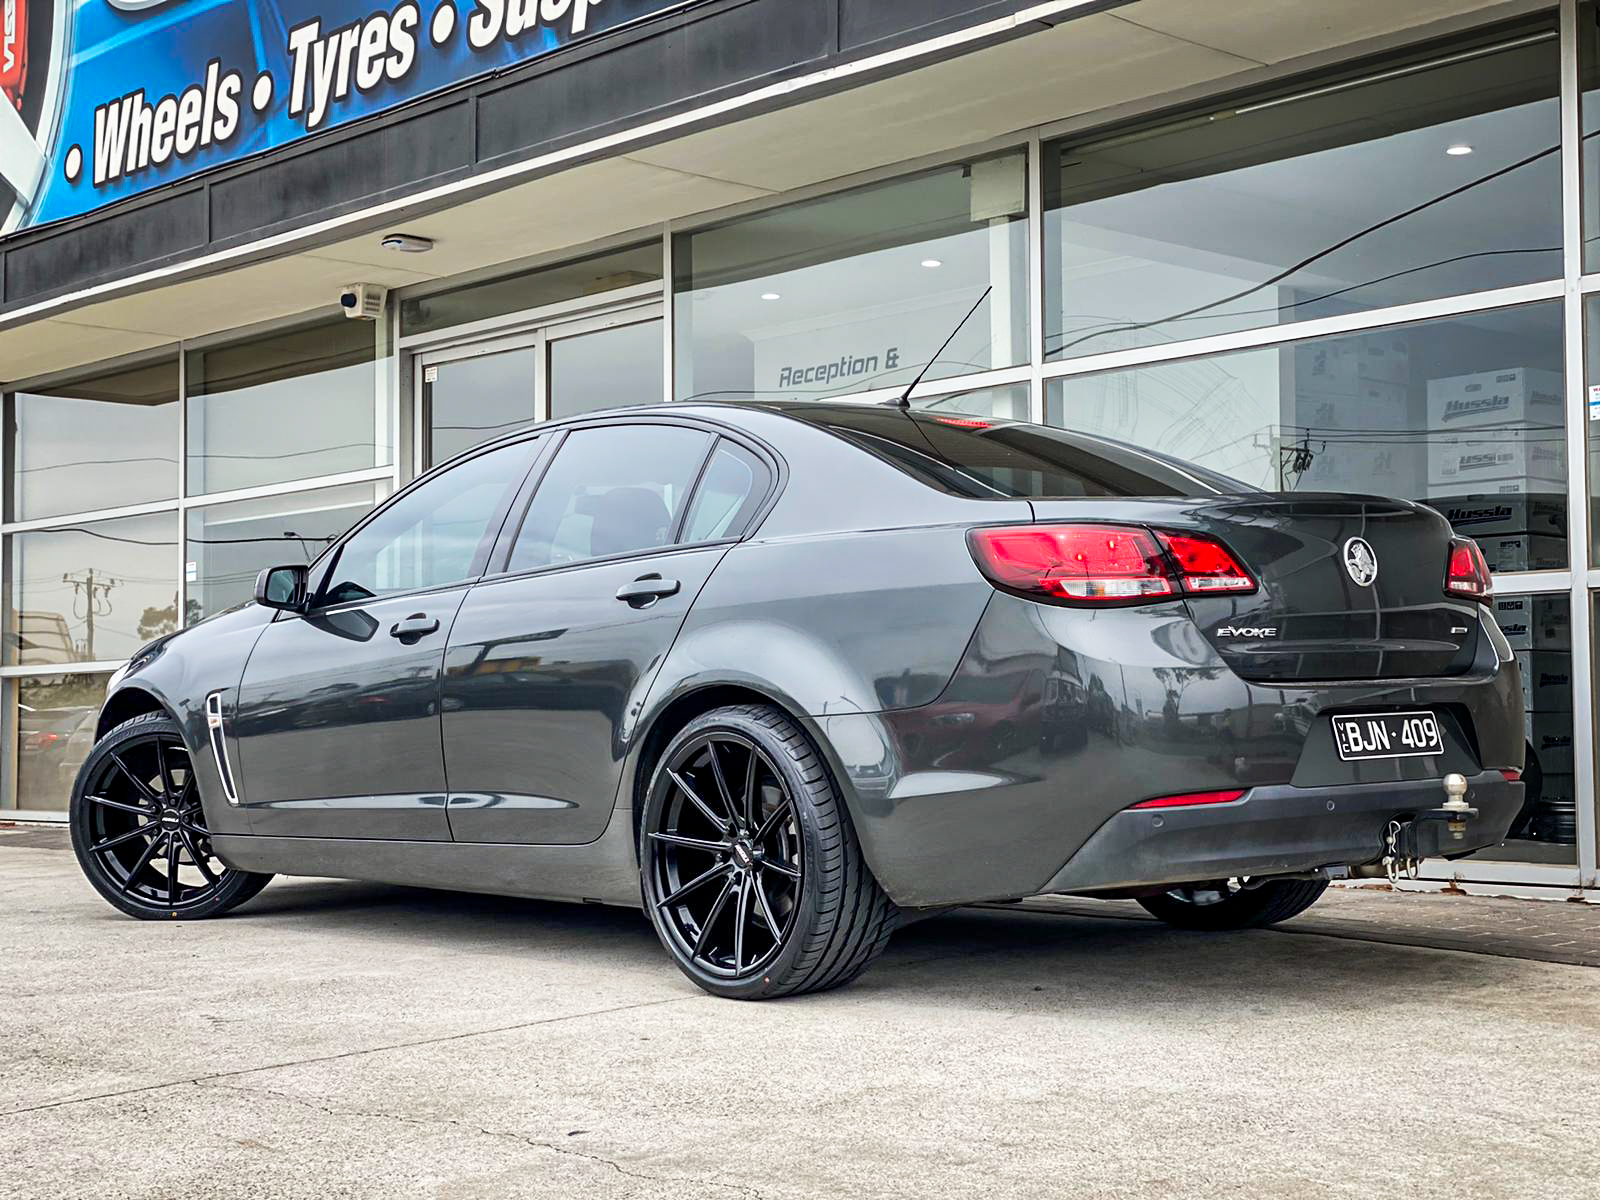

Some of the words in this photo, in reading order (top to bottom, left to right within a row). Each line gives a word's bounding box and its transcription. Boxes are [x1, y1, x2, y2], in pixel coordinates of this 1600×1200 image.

[94, 76, 240, 184] Wheels
[288, 17, 418, 127] Tyres
[779, 355, 878, 388] Reception
[885, 347, 899, 369] &
[1217, 625, 1277, 638] EVOKE
[1337, 722, 1350, 752] VIC
[1345, 720, 1391, 752] BJN
[1402, 718, 1438, 748] 409
